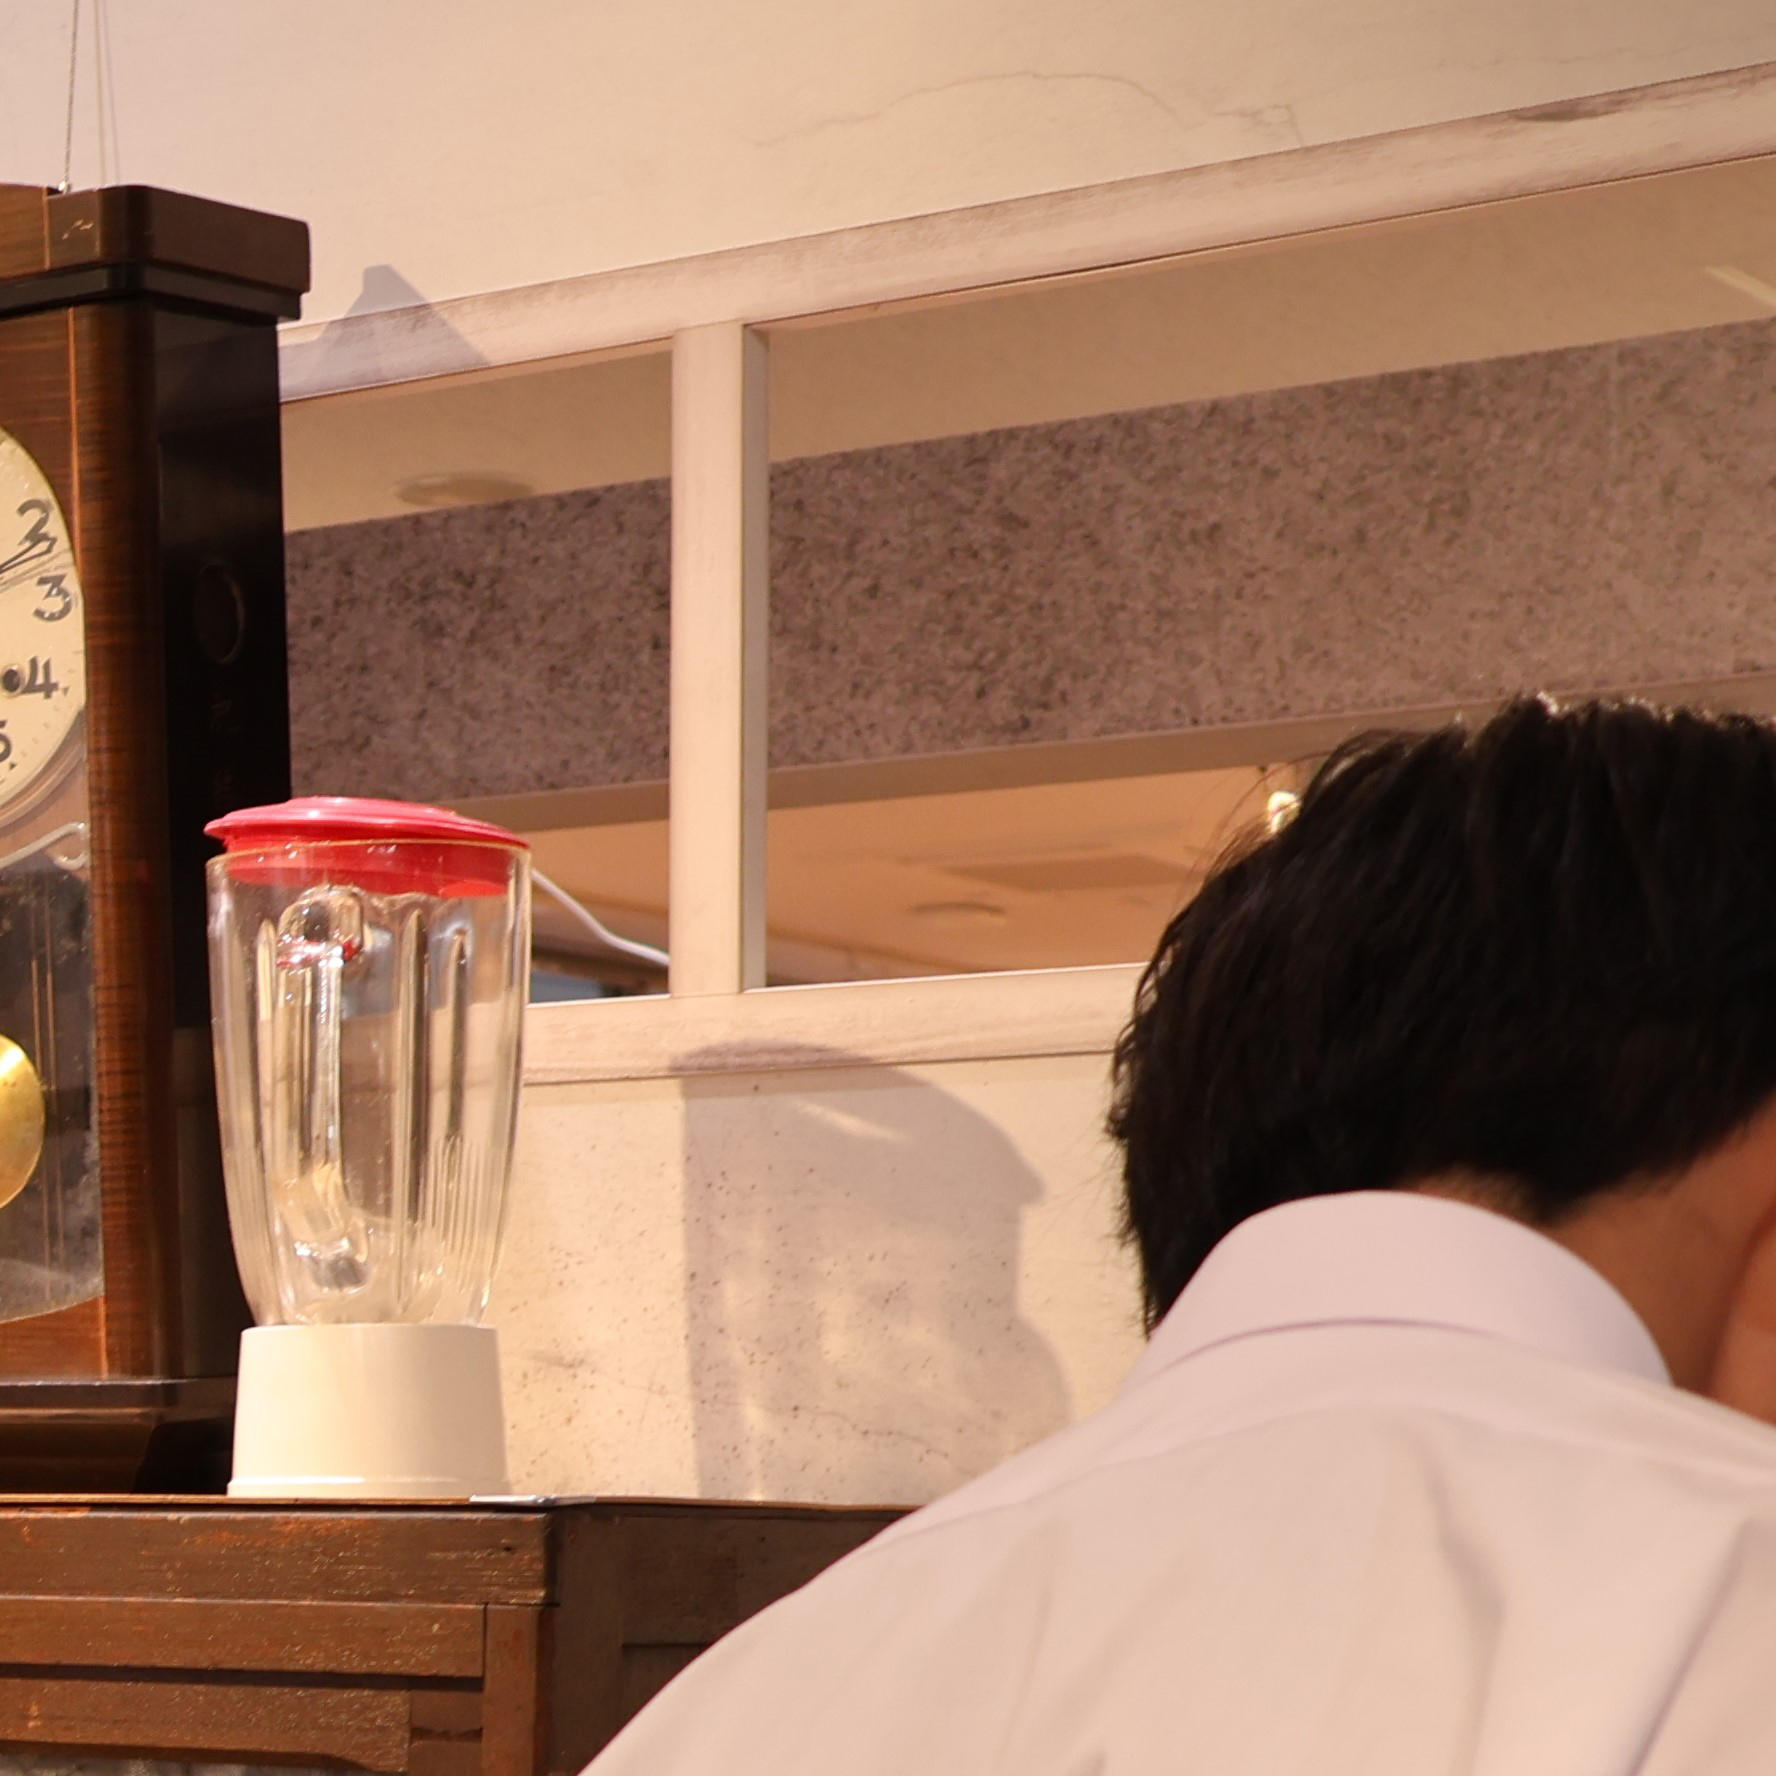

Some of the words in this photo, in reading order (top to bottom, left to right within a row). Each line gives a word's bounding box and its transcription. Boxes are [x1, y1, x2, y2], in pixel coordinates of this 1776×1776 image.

[17, 500, 55, 545] 2
[33, 573, 72, 622] 3
[23, 656, 58, 699] 4
